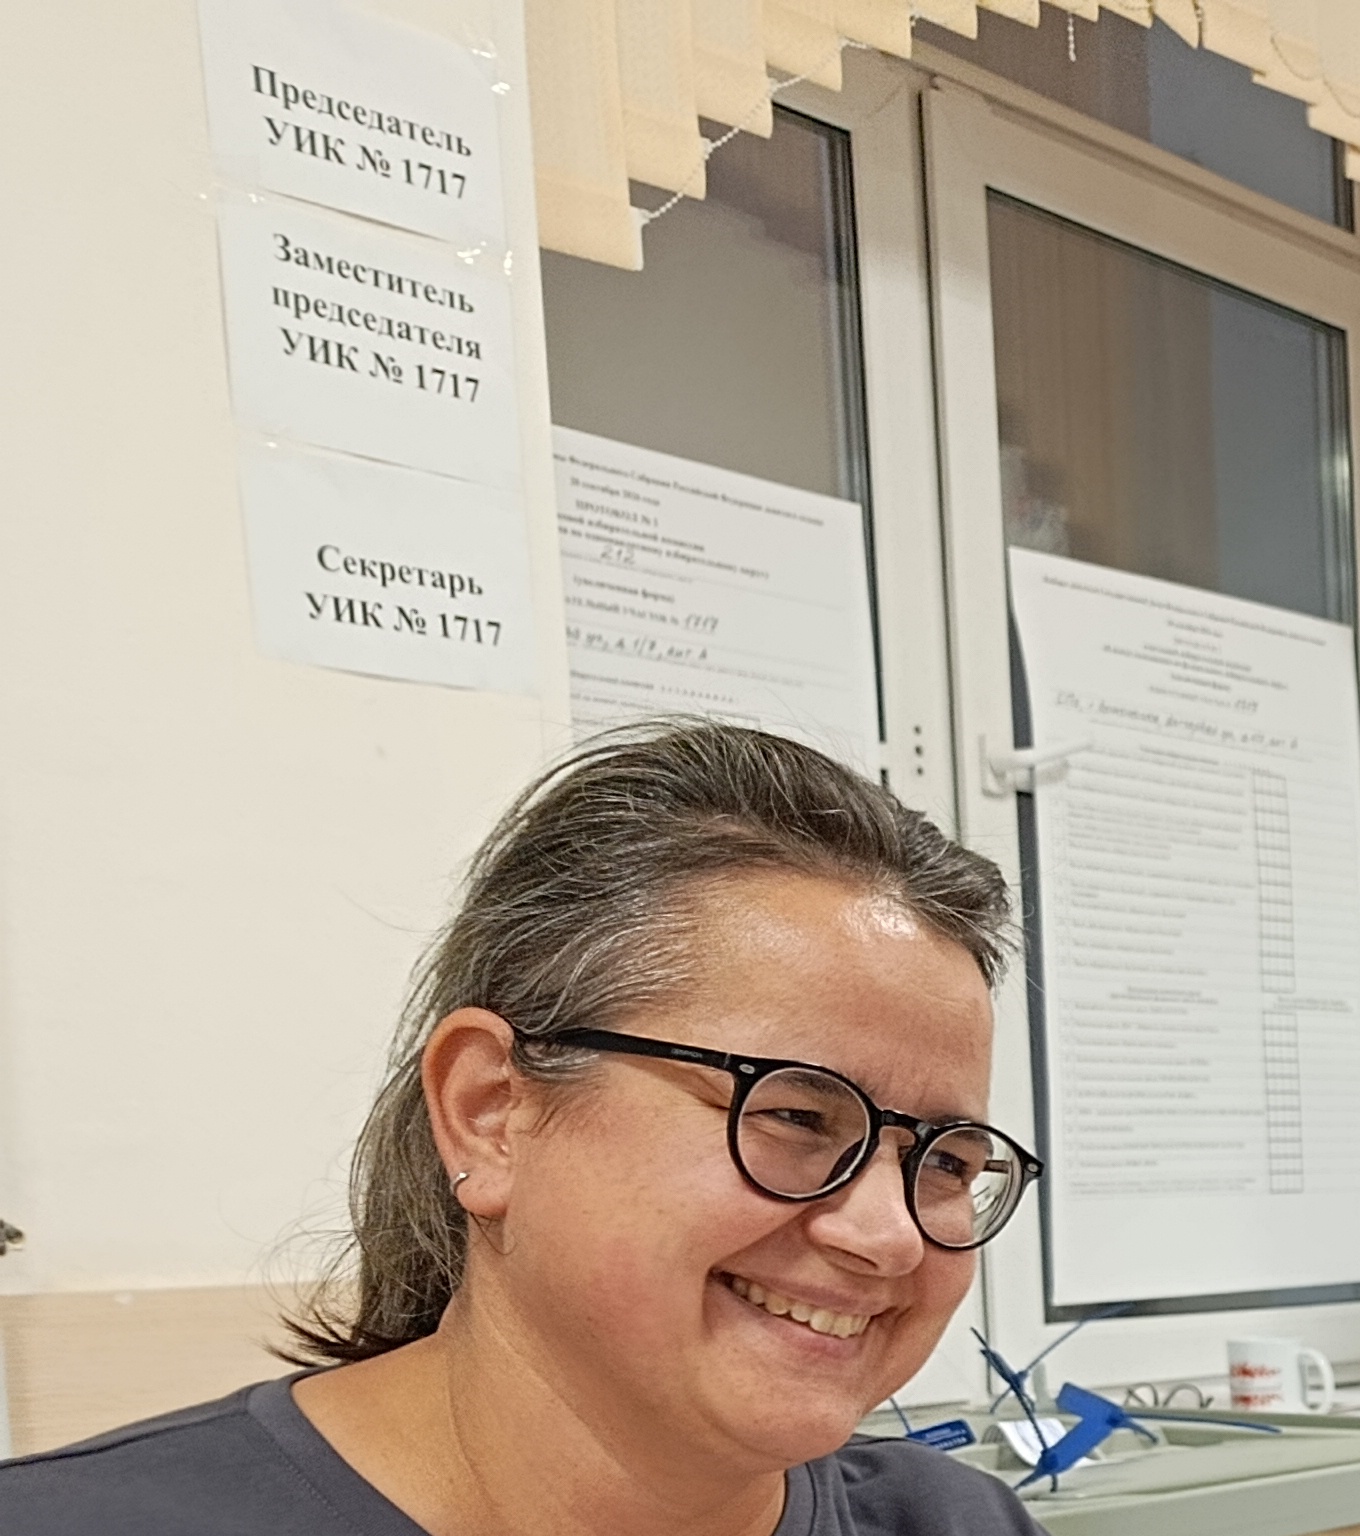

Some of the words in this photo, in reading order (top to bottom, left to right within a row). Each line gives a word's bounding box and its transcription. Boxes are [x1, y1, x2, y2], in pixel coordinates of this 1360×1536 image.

[250, 64, 473, 158] Председатель
[262, 117, 346, 166] УИК
[356, 149, 392, 181] №
[400, 158, 467, 200] 1717
[272, 233, 475, 314] Заместитель
[272, 284, 482, 361] председателя
[278, 328, 358, 374] УИК
[368, 353, 404, 385] №
[414, 362, 480, 404] 1717
[316, 544, 484, 597] Секретарь
[303, 592, 383, 631] УИК
[391, 605, 428, 635] №
[437, 615, 503, 648] 1717
